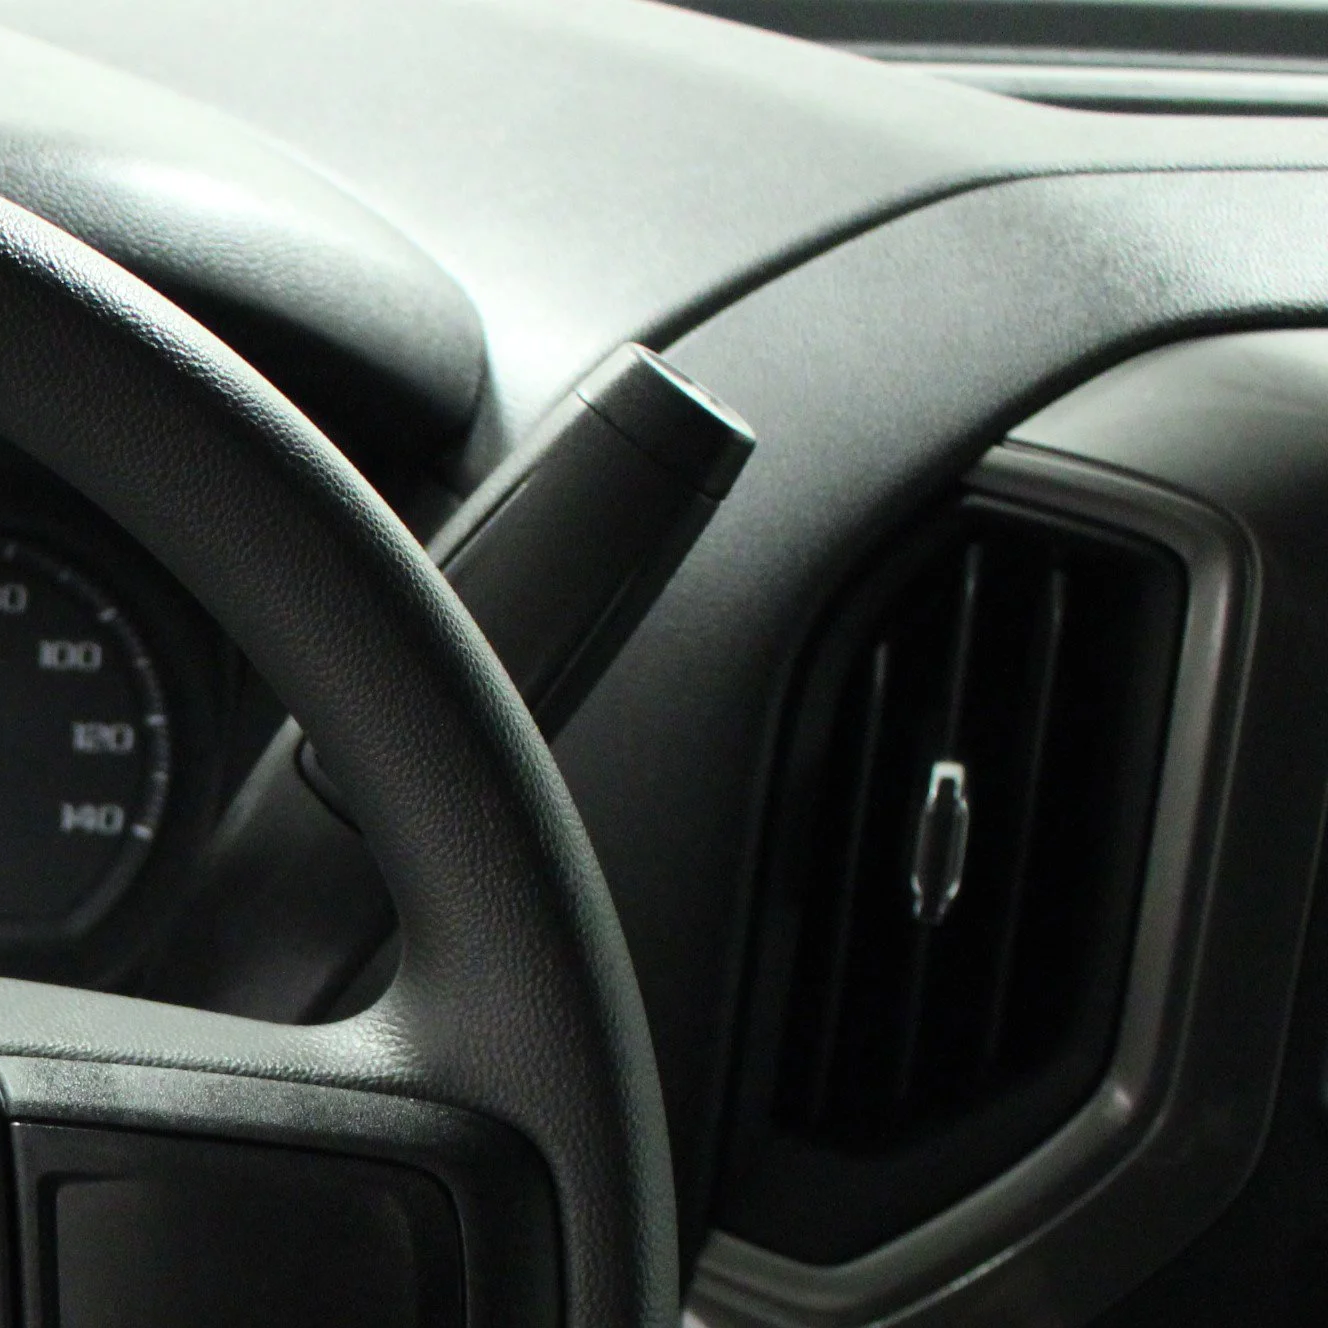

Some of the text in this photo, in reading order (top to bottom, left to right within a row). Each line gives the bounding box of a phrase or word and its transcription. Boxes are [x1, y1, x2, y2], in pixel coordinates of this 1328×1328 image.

[38, 640, 103, 671] 100
[71, 722, 135, 754] 120
[59, 803, 126, 835] 140
